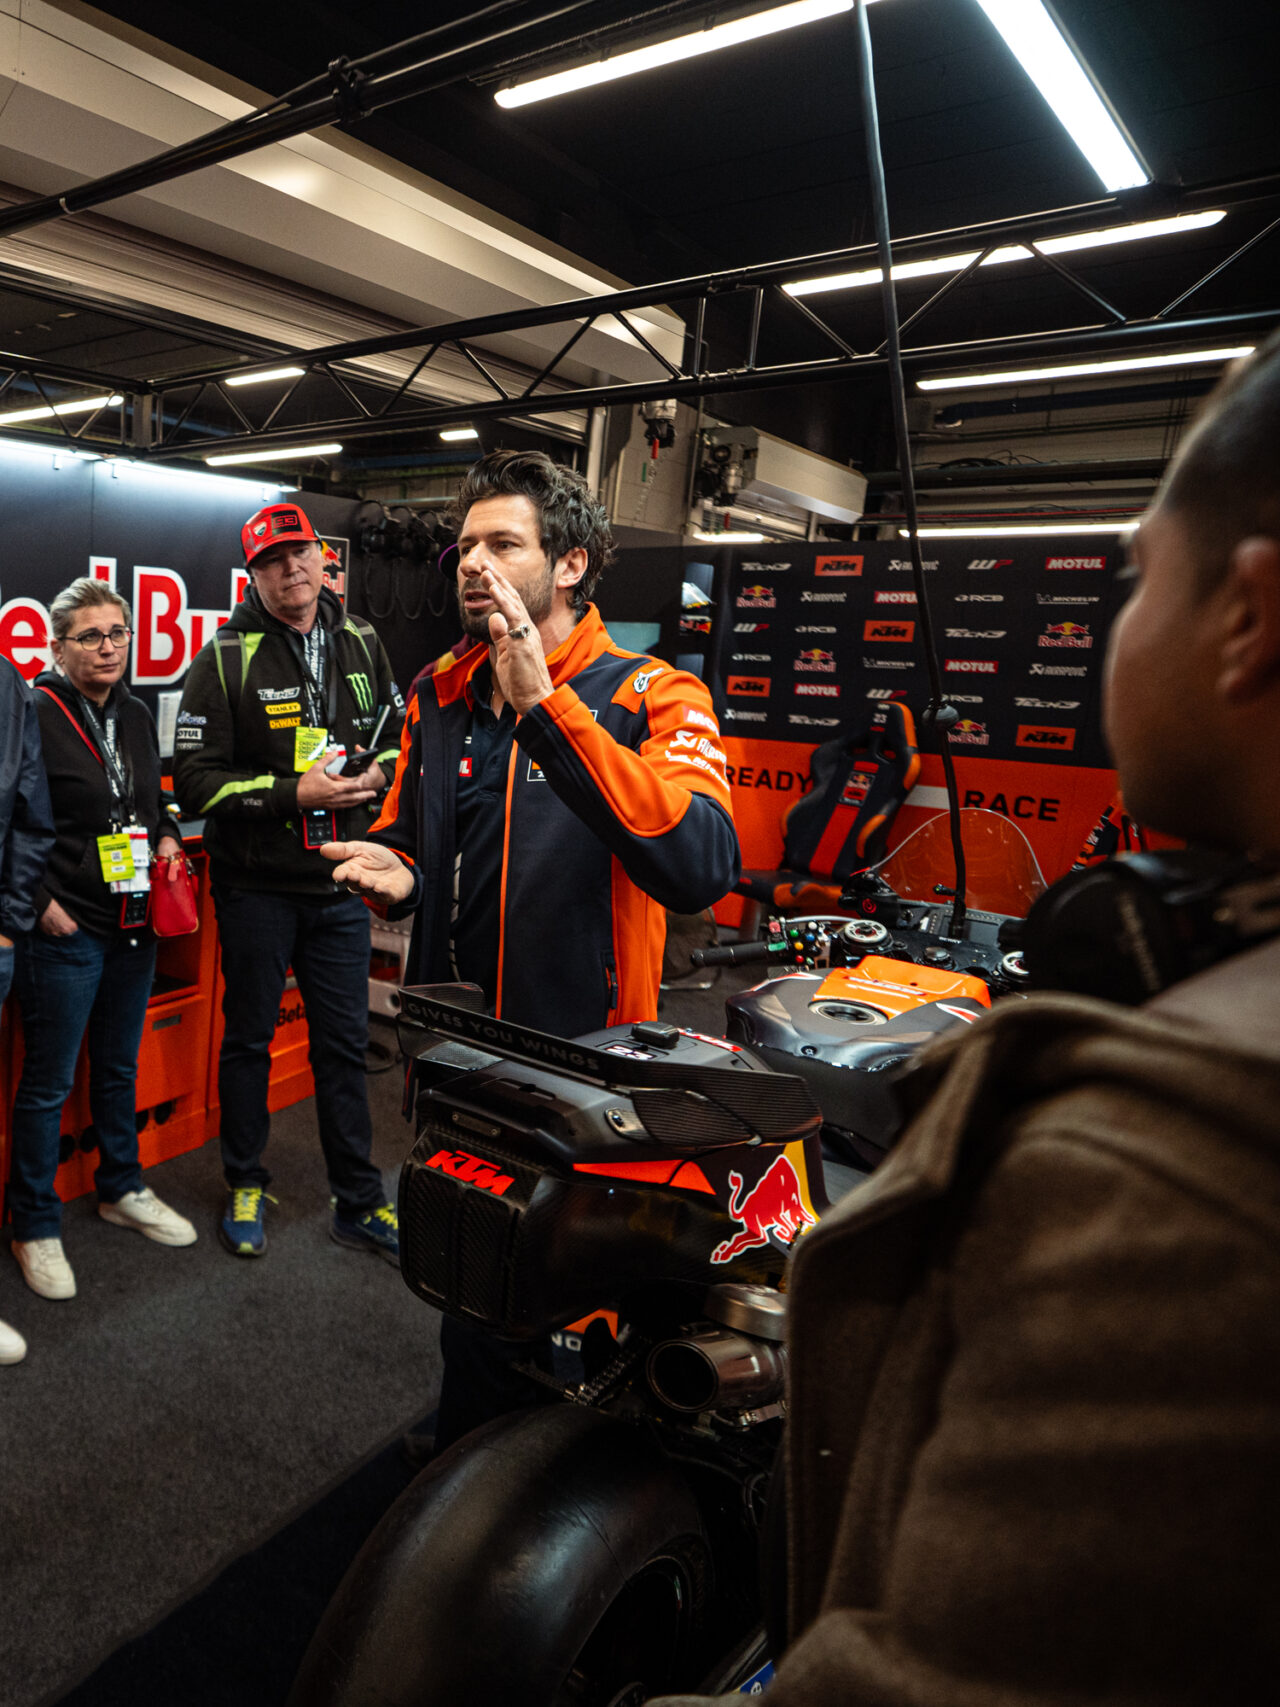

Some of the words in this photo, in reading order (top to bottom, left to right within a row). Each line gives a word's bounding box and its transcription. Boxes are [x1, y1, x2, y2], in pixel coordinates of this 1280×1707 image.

[273, 514, 299, 530] 93
[821, 560, 857, 572] KTM
[1047, 557, 1104, 570] MOTUL
[876, 592, 918, 604] MOTU
[870, 626, 908, 638] KTM
[1037, 635, 1064, 647] Red
[1064, 636, 1093, 649] Bull
[946, 660, 996, 673] MOTUL
[733, 680, 766, 692] KTM
[796, 685, 839, 697] MOTUL
[1023, 731, 1067, 745] KTM
[726, 766, 814, 793] READY
[964, 789, 1060, 822] RACE
[407, 1002, 464, 1029] GIVES
[470, 1020, 514, 1044] YOU
[520, 1035, 601, 1071] WINGS
[425, 1149, 515, 1197] KTM
